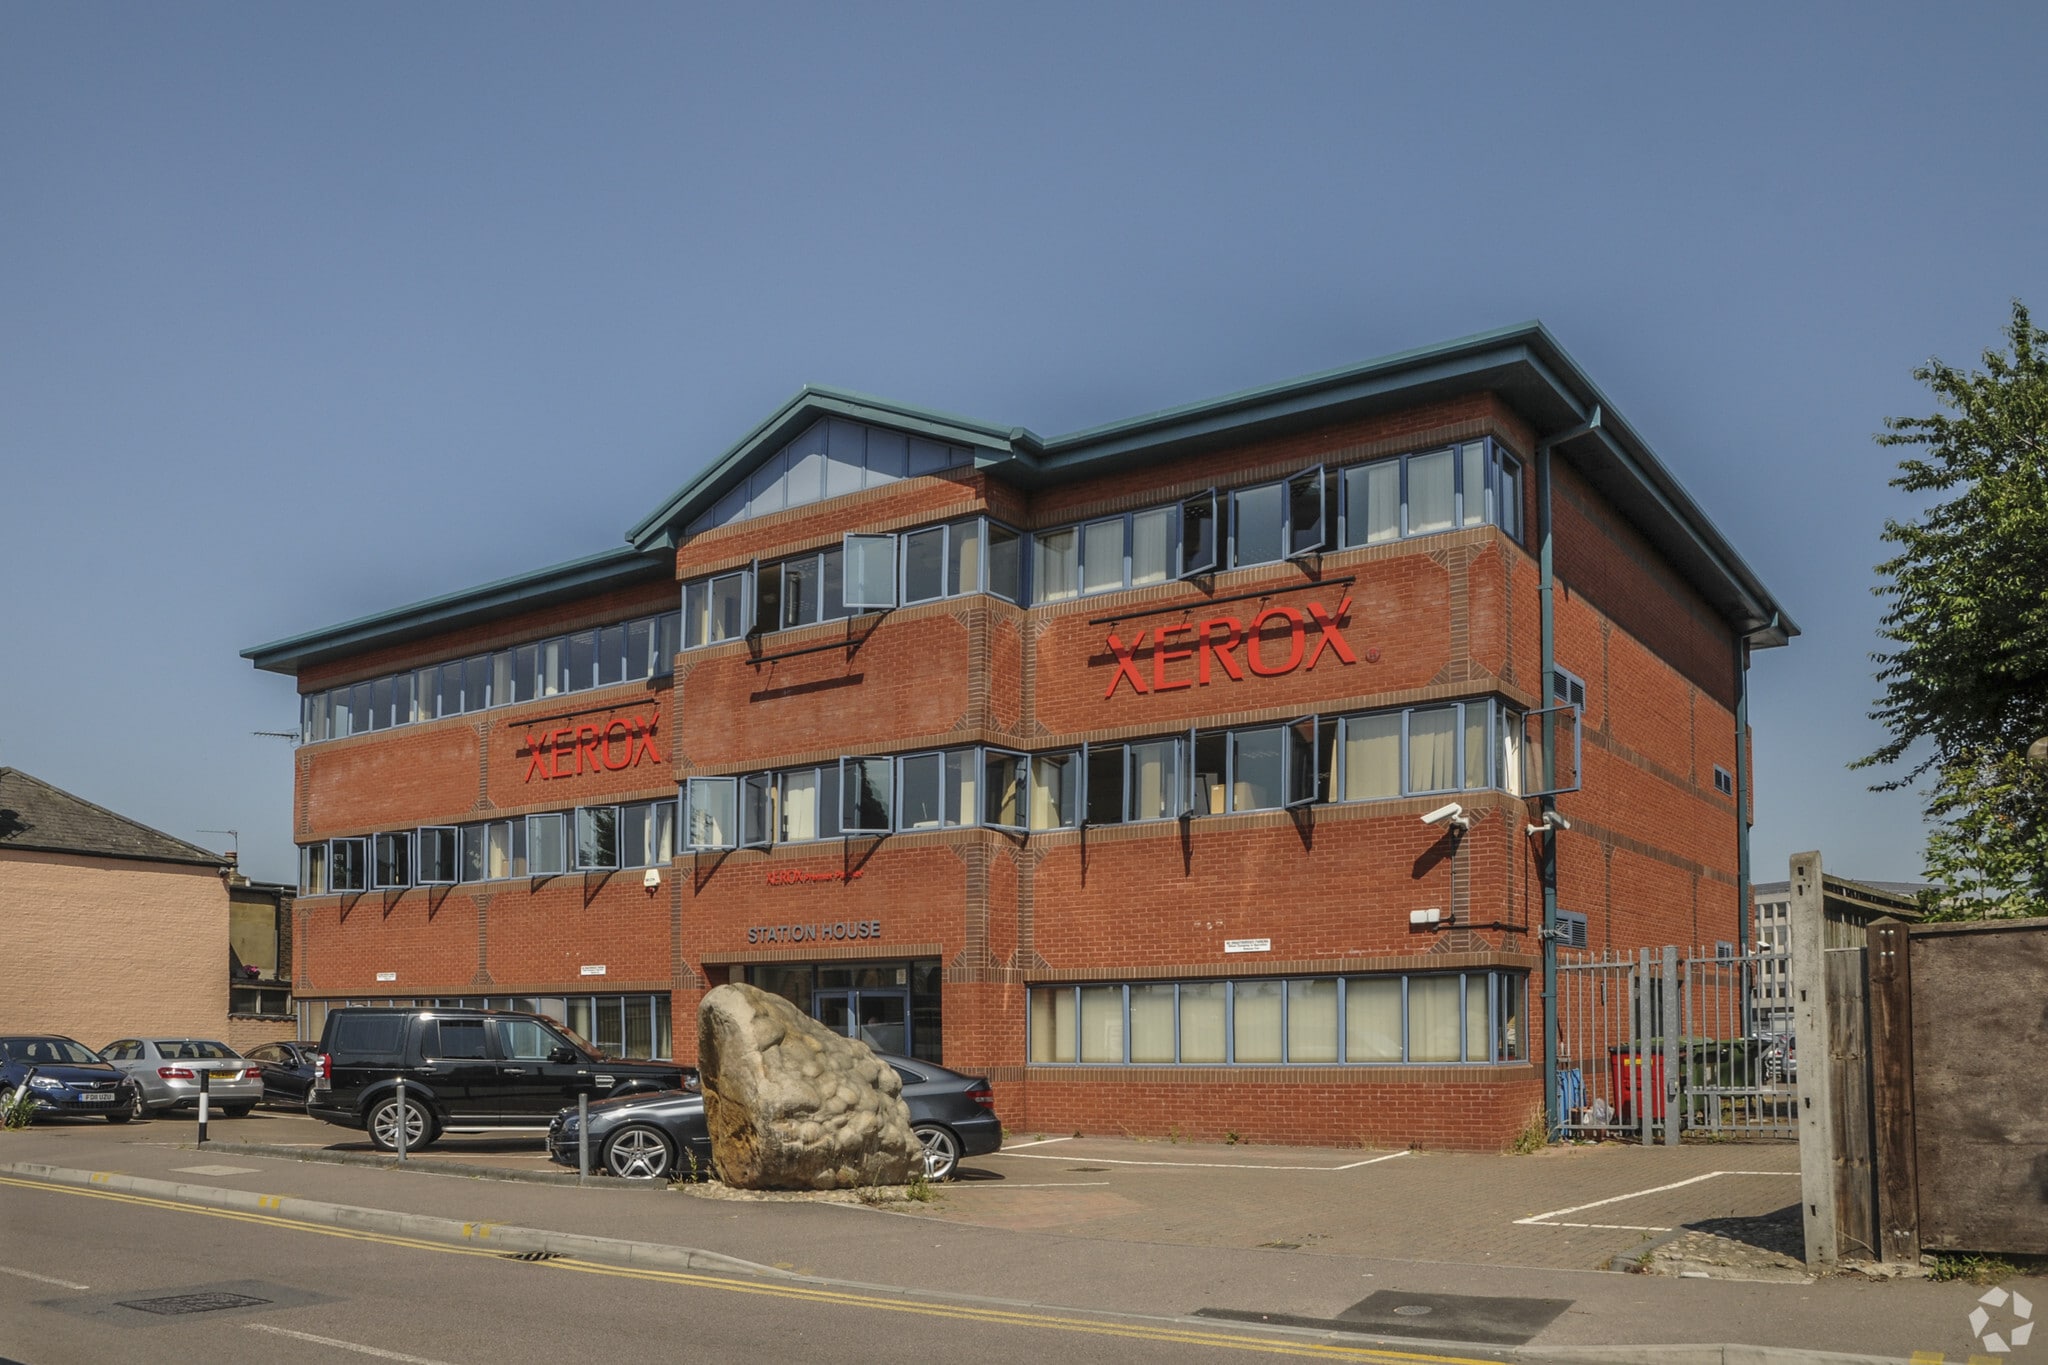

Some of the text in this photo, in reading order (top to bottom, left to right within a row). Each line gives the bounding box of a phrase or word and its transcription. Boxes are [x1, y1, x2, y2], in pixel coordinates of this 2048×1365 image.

[1104, 596, 1357, 700] XEROX
[525, 711, 662, 783] XEROX
[767, 869, 803, 885] XEROX
[748, 919, 881, 944] STATION HOUSE
